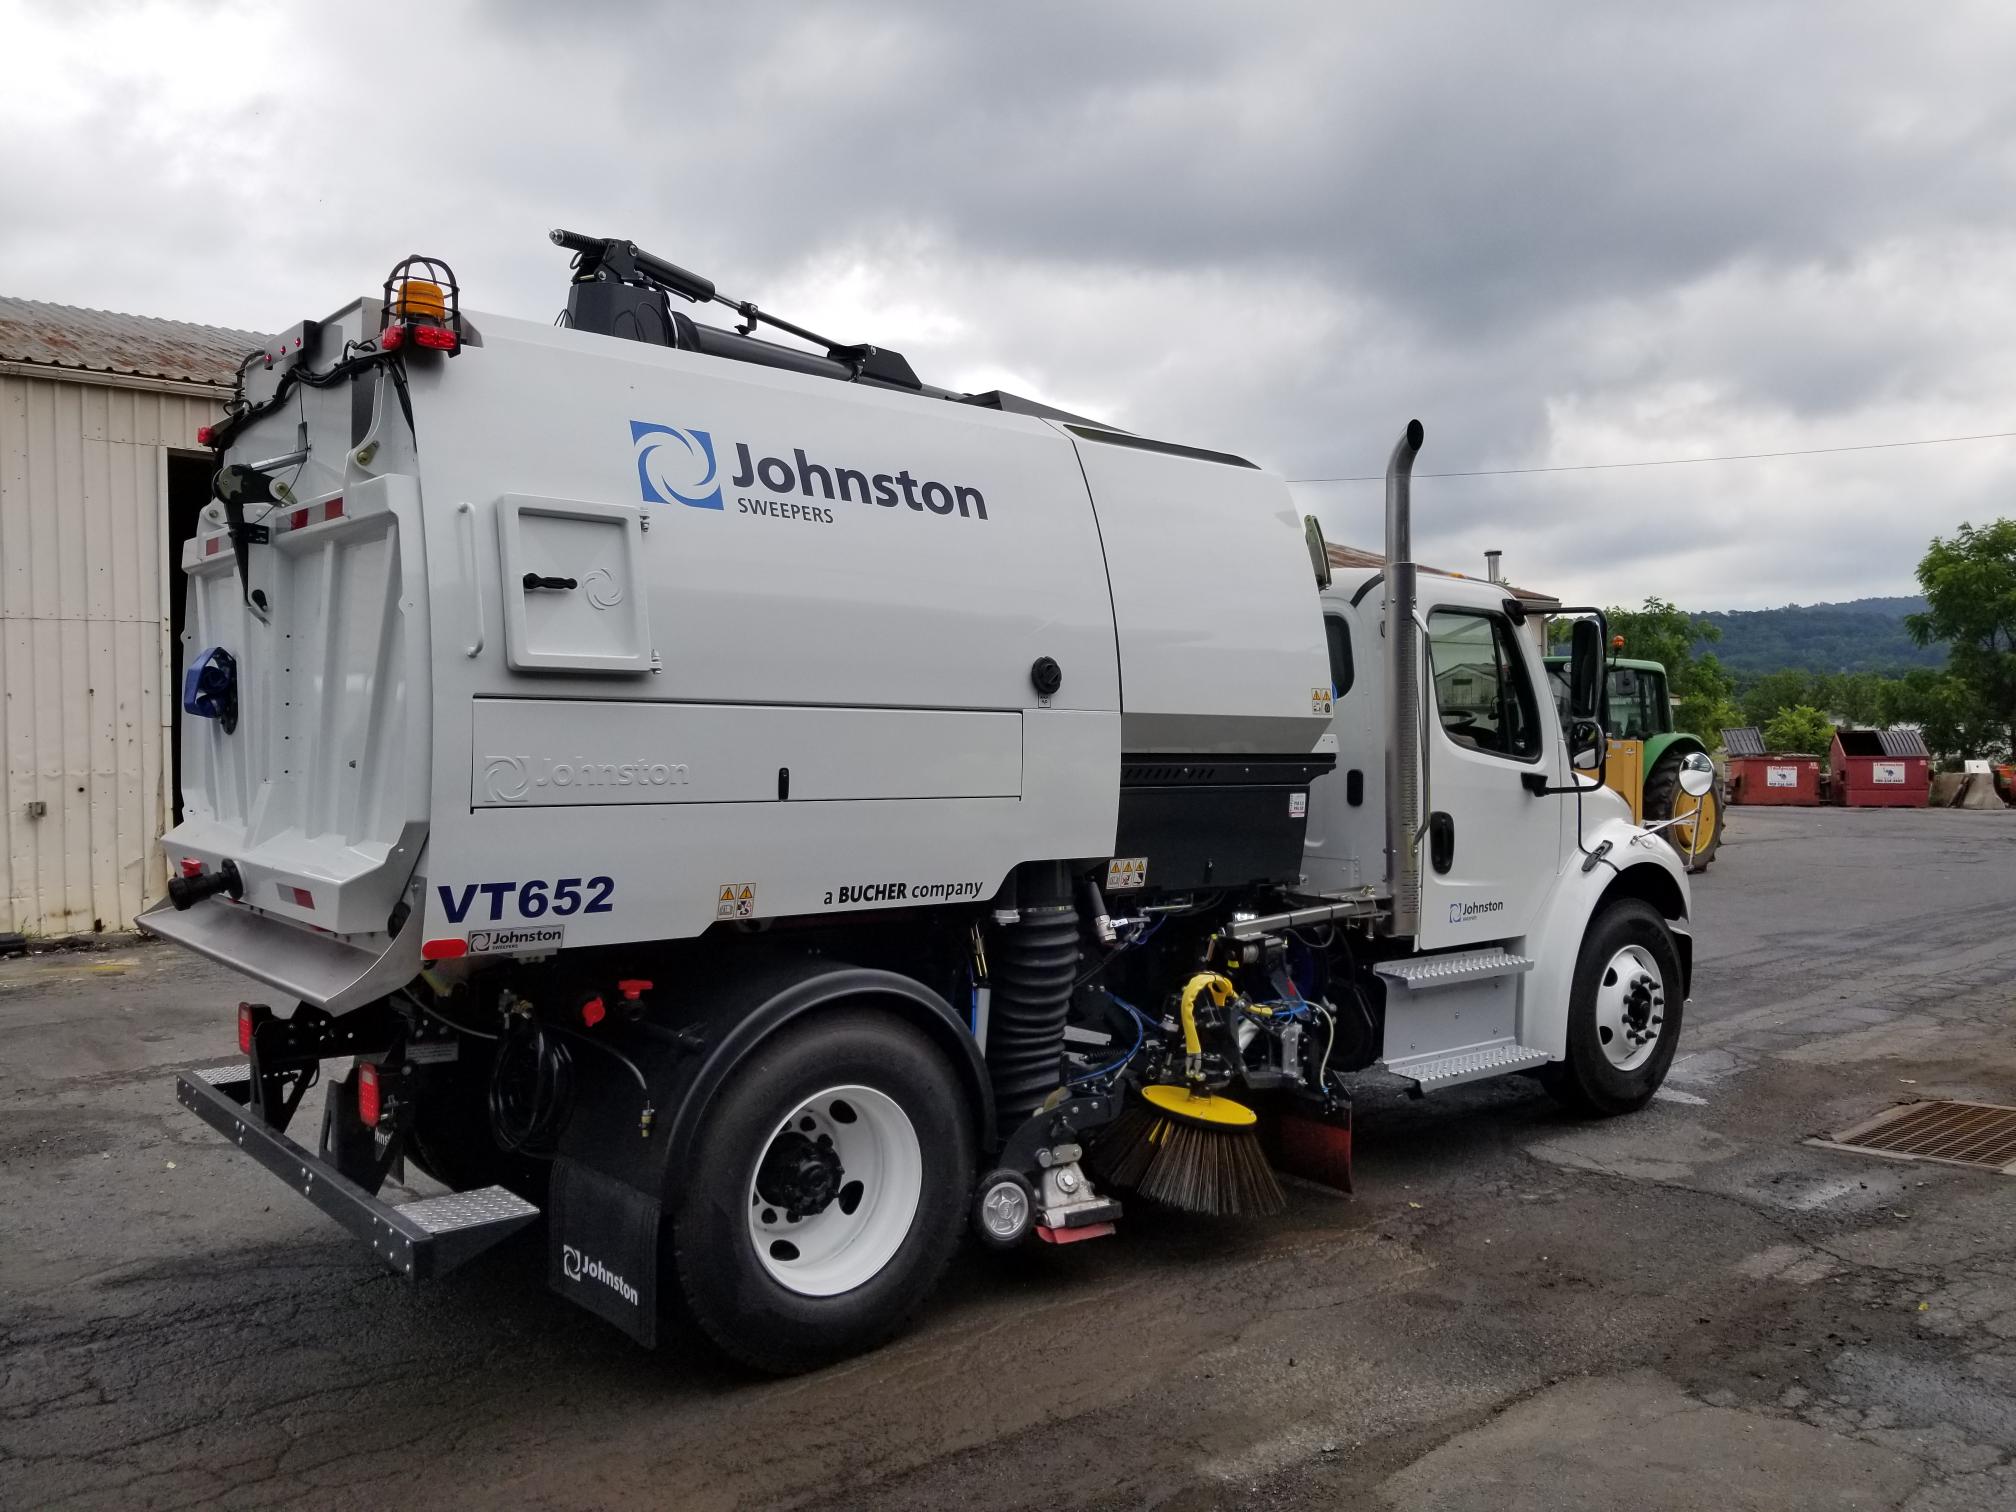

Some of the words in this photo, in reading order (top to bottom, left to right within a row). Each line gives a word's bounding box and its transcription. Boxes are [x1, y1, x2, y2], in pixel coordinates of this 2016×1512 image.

[732, 442, 989, 521] Johnston
[737, 497, 834, 524] SWEEPERS
[536, 755, 689, 787] Johnston
[437, 876, 615, 924] VT652
[824, 891, 833, 905] a
[838, 882, 908, 904] BUCHER
[912, 881, 984, 902] company
[1462, 900, 1504, 916] Johnston
[492, 930, 562, 945] Johnston
[582, 1255, 639, 1307] Johnston
